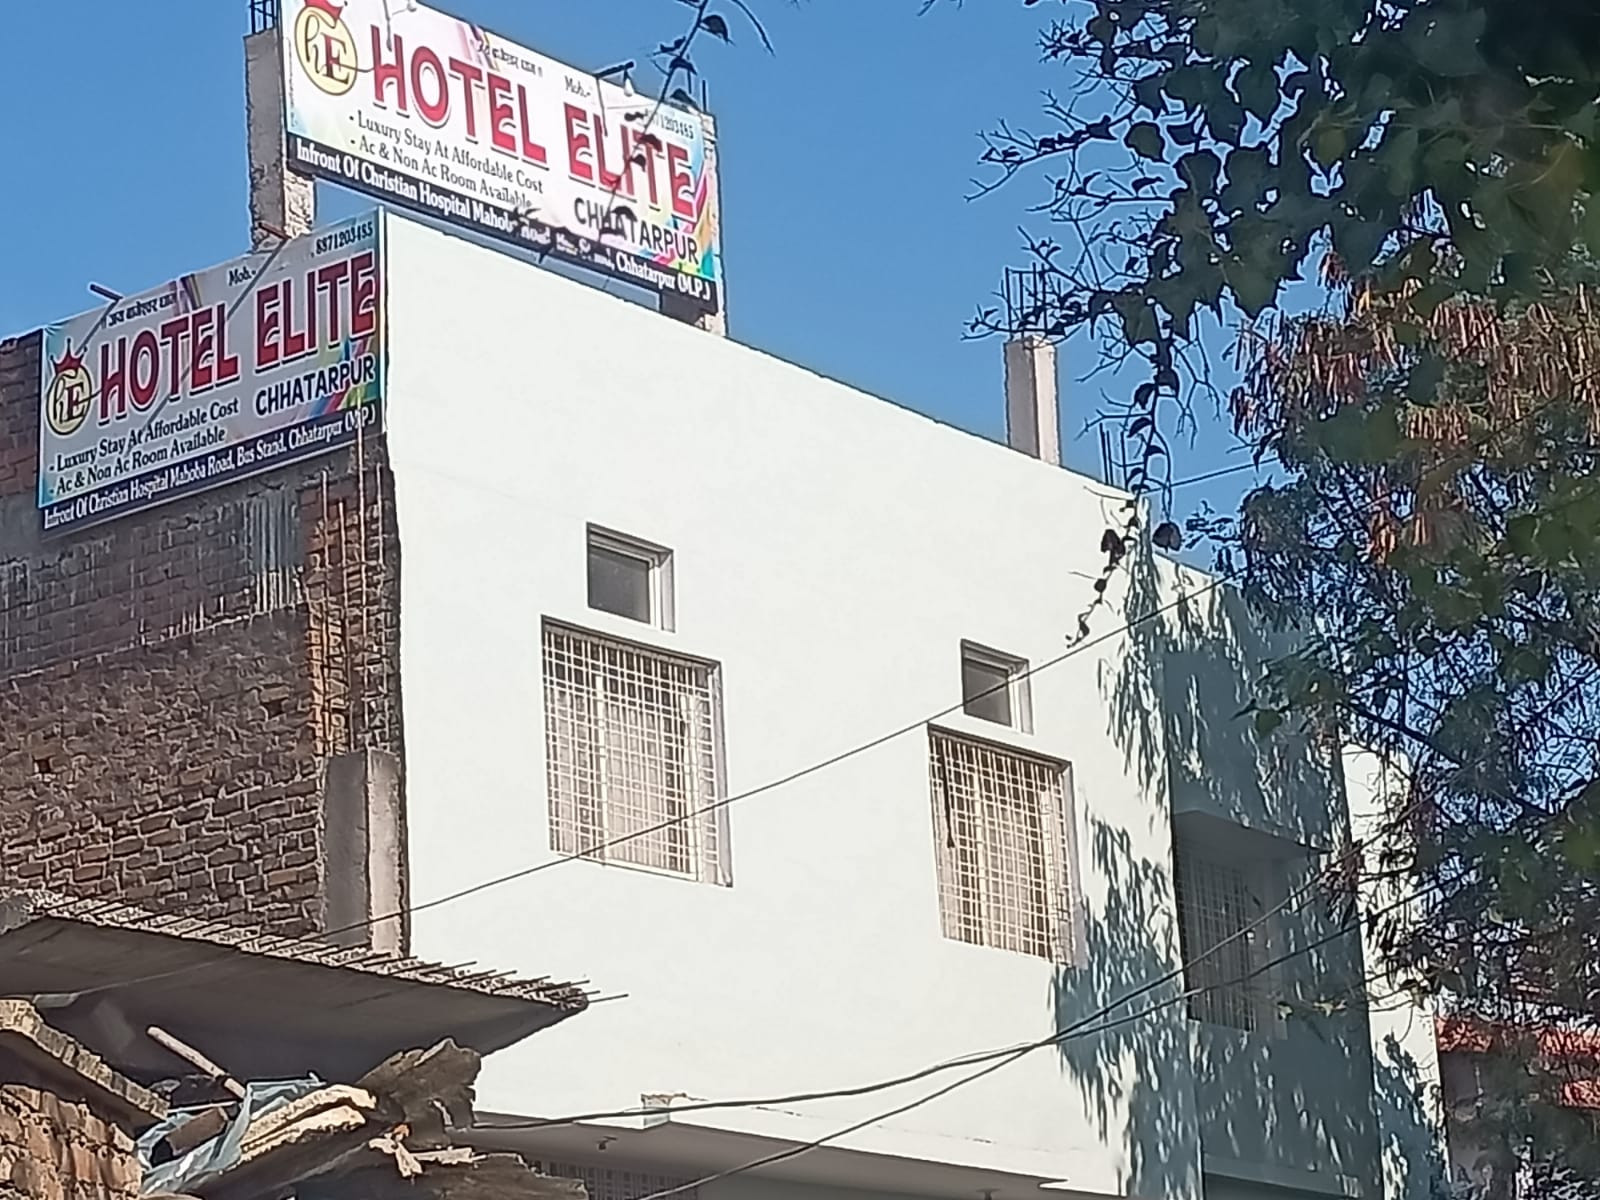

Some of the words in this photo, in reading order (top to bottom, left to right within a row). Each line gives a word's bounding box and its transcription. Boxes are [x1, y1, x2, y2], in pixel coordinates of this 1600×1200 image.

[357, 110, 401, 143] Luxury
[404, 127, 432, 154] Stay
[435, 140, 450, 160] At
[451, 146, 513, 180] Affordable
[515, 170, 543, 194] Cost
[370, 24, 548, 168] HOTEL
[563, 101, 697, 220] ELITE
[359, 135, 376, 157] Ac
[379, 145, 390, 160] &
[392, 148, 419, 172] Non
[421, 161, 437, 179] Ac
[440, 166, 477, 191] Room
[479, 182, 533, 208] Available
[296, 138, 342, 174] Infront
[342, 155, 359, 180] Of
[361, 162, 418, 200] Christian
[419, 181, 470, 217] Hospital
[615, 252, 675, 290] Chhatarpur
[100, 302, 239, 420] HOTEL
[257, 250, 375, 366] ELITE
[255, 354, 374, 416] CHHATARPUR
[56, 476, 73, 496] Ac
[74, 471, 85, 488] &
[87, 463, 113, 485] Non
[114, 457, 130, 476] Ac
[132, 447, 168, 470] Room
[170, 425, 225, 458] Available
[57, 448, 98, 473] Luxury
[99, 435, 126, 457] Stay
[128, 427, 143, 447] At
[145, 407, 207, 443] Affordable
[209, 398, 239, 422] Cost
[76, 494, 90, 518] Of
[89, 483, 129, 514] Christian
[130, 468, 169, 500] Hospital
[208, 450, 235, 477] Road,
[236, 445, 255, 467] Bus
[256, 432, 287, 460] Stand,
[288, 417, 344, 450] Chhatarpur
